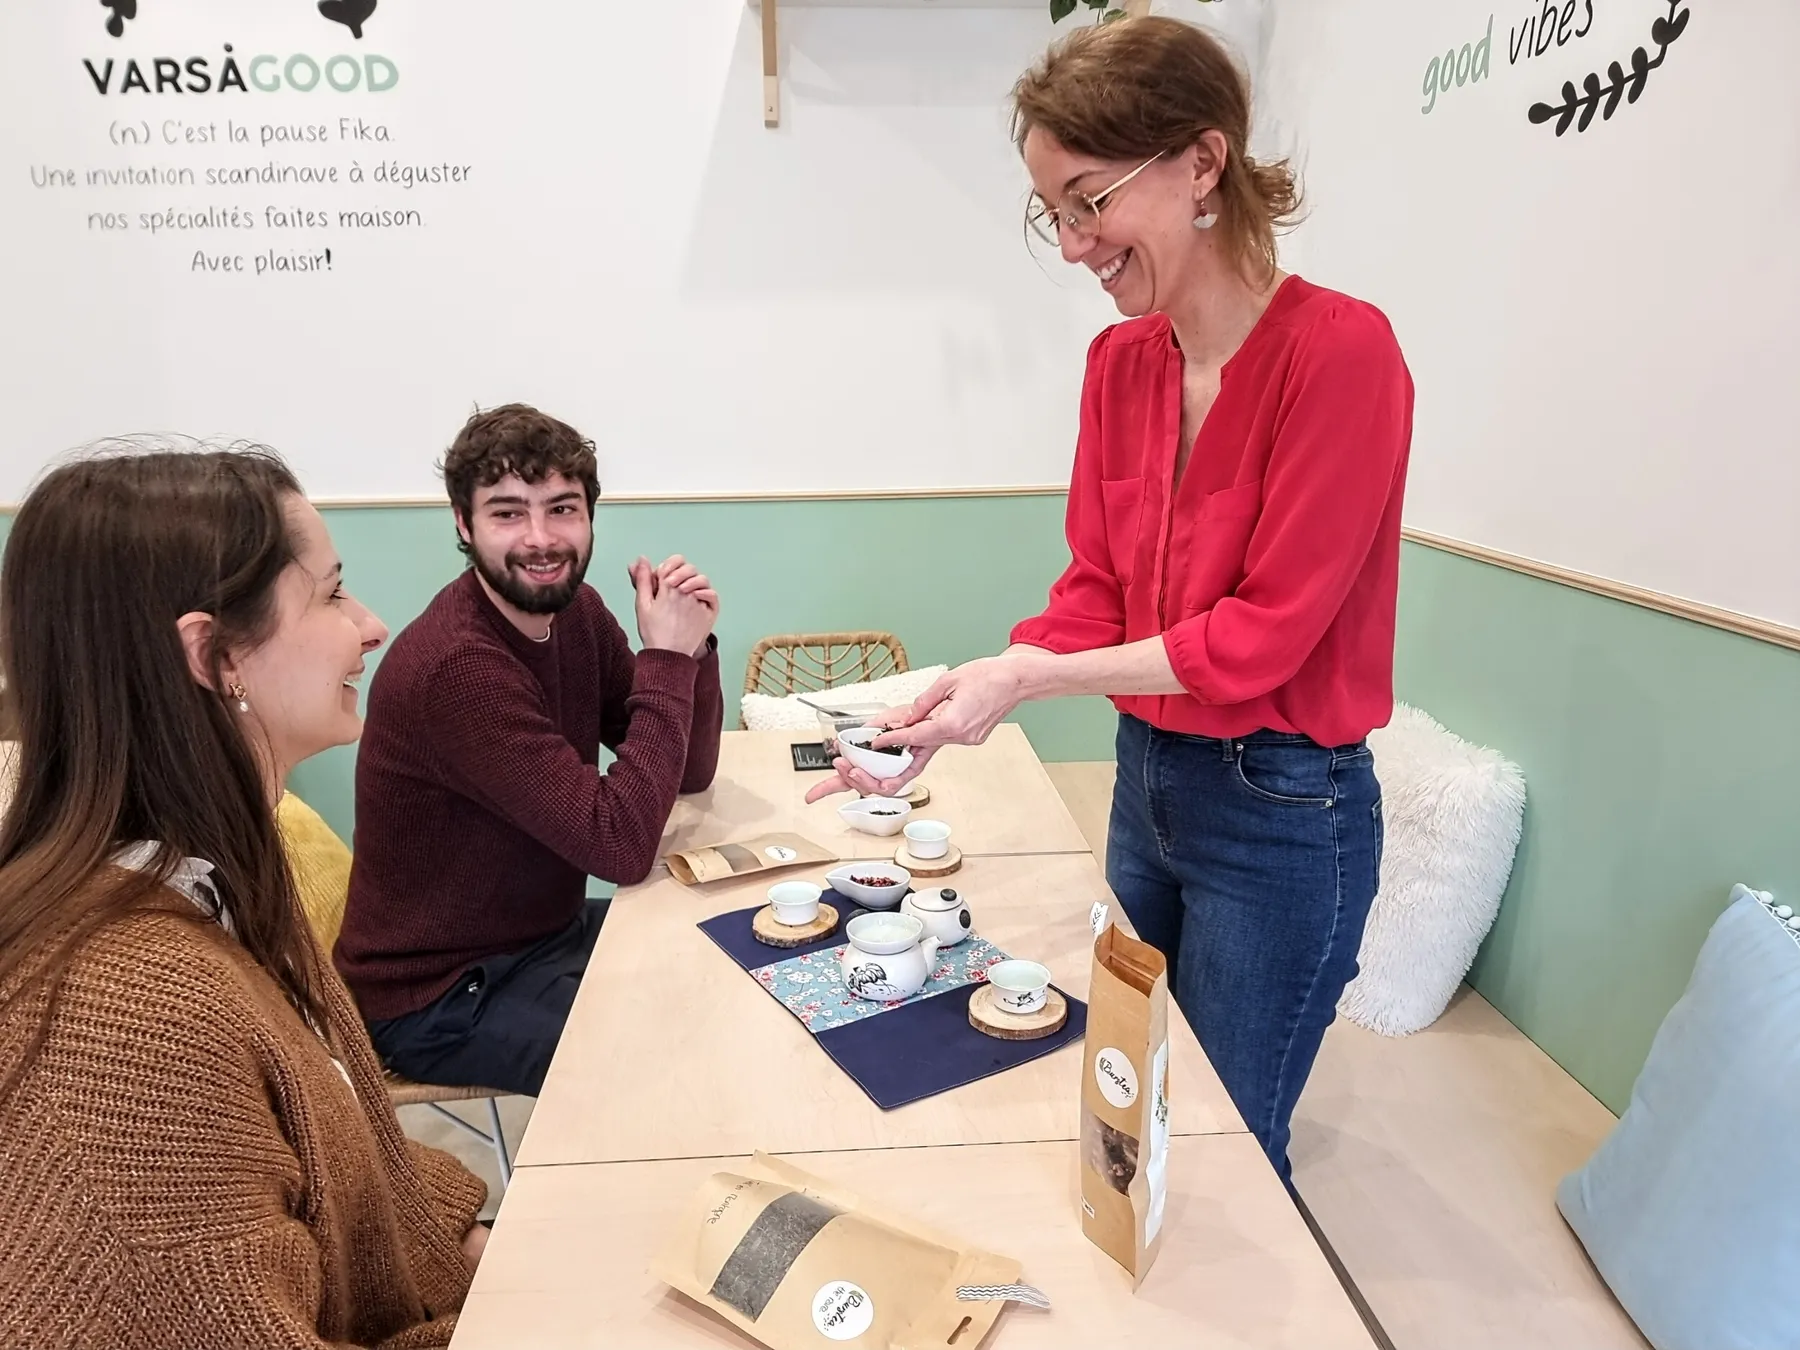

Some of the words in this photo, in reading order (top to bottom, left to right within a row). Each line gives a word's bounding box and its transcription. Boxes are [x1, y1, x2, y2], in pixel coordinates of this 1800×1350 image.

[1421, 13, 1494, 115] good
[162, 118, 216, 145] C'est
[227, 118, 250, 143] la
[260, 124, 328, 148] pause
[30, 164, 77, 188] Une
[86, 164, 195, 186] invitation
[205, 161, 339, 187] scandinave
[349, 159, 365, 184] à
[373, 159, 472, 190] déguster
[88, 211, 129, 231] nos
[138, 204, 255, 236] spécialités
[265, 205, 329, 229] faites
[191, 249, 244, 272] Avec
[254, 247, 333, 276] plaisir!
